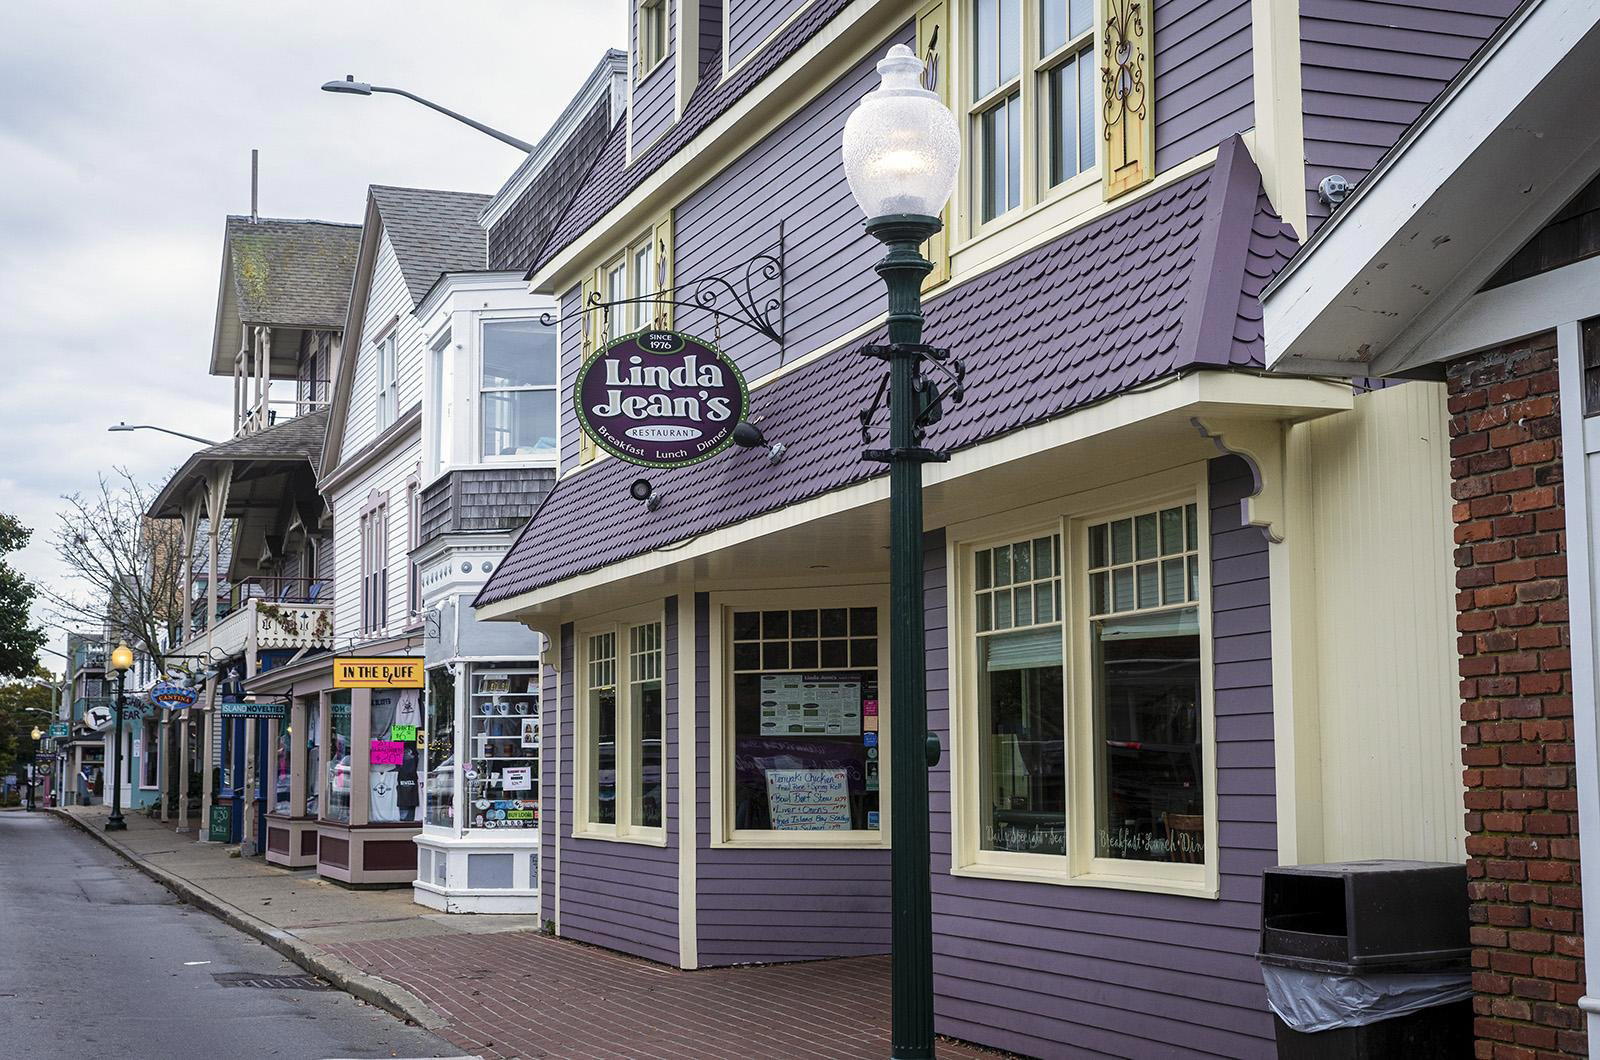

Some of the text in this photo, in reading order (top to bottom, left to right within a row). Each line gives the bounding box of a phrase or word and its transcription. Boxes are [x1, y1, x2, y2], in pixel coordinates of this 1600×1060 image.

[650, 341, 672, 350] 1976
[604, 355, 724, 391] Linda
[592, 389, 732, 422] Jean's
[599, 425, 728, 459] Breakfast Lunch Dinner
[632, 429, 695, 437] RESTAURANT
[343, 666, 354, 678] IN
[358, 666, 378, 678] THE
[247, 705, 284, 713] NOVELTIES
[1099, 828, 1141, 857] Breakfast
[1145, 829, 1176, 852] Lunch
